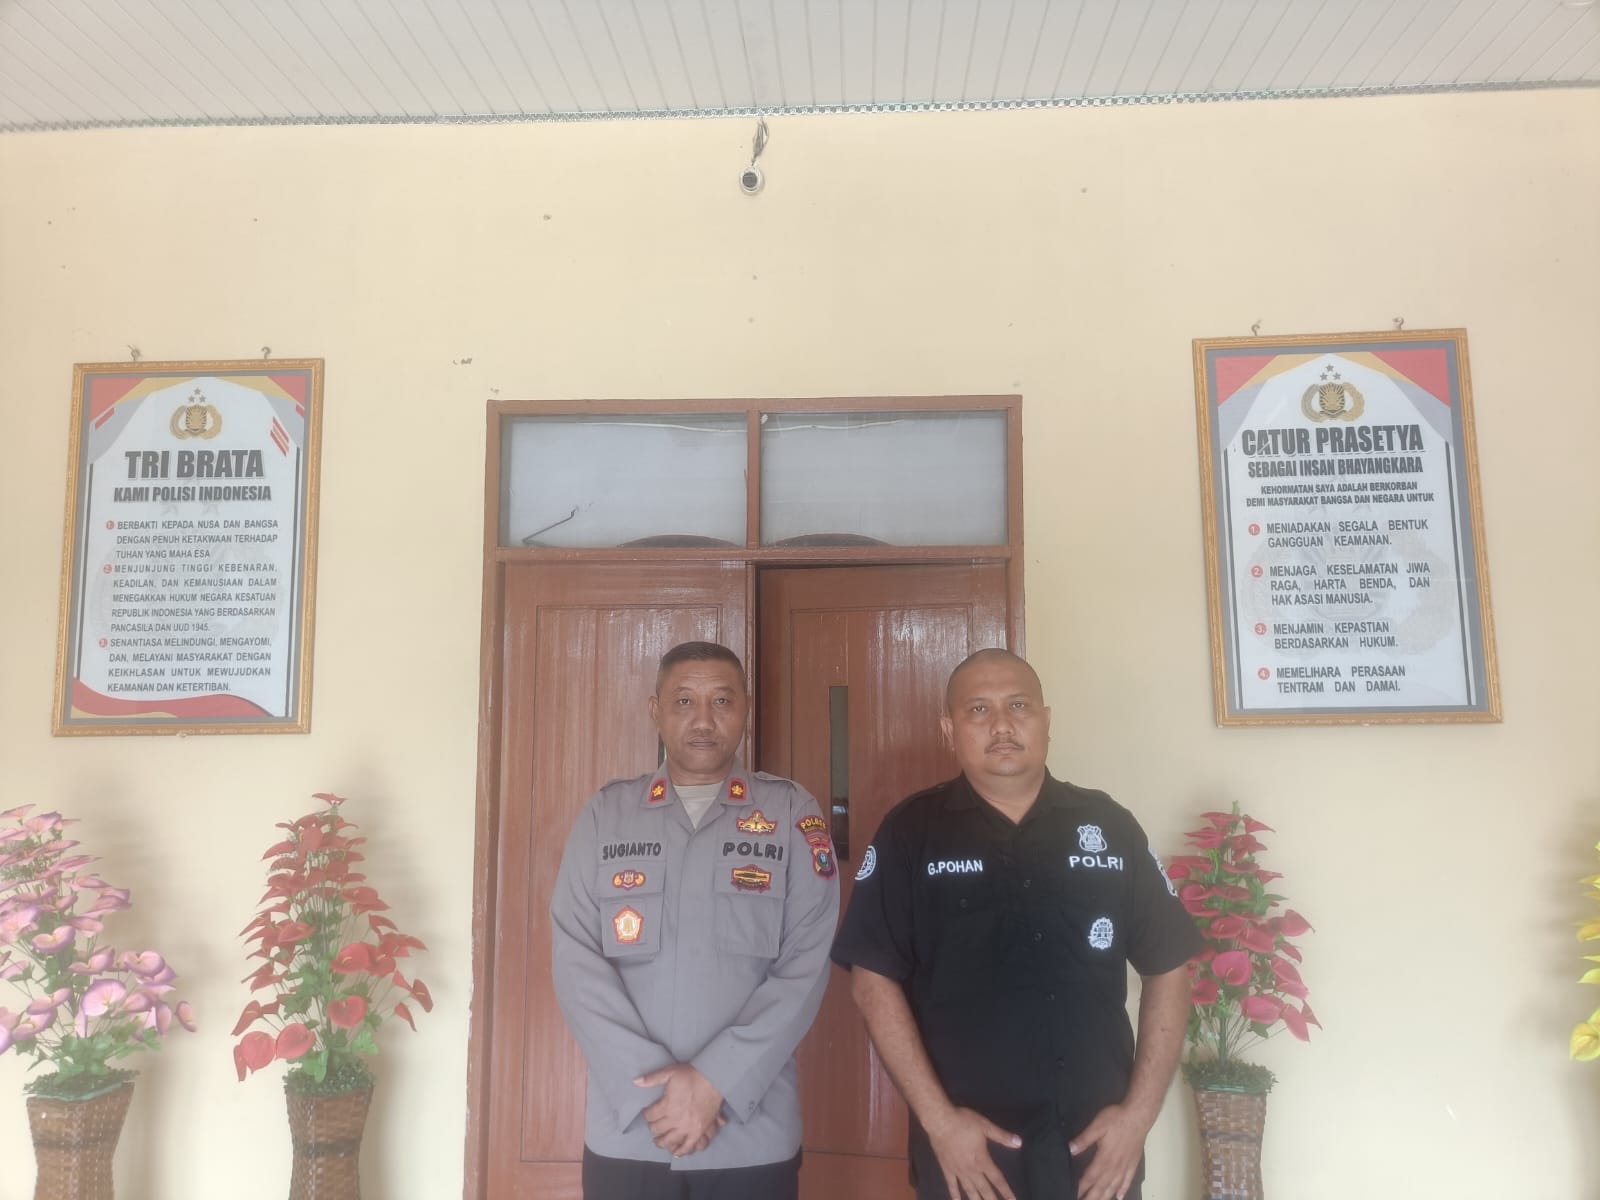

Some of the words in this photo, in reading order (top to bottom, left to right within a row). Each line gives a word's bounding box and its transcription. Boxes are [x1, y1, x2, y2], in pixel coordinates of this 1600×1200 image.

[1242, 428, 1310, 456] CATUR
[1316, 424, 1424, 453] PRASETYA
[125, 451, 170, 478] TRI
[177, 450, 264, 478] BRATA
[1248, 460, 1297, 478] SEBAGAI
[1300, 459, 1335, 476] INSAN
[1338, 456, 1423, 475] BHAYANGKARA
[114, 488, 149, 502] KAMI
[152, 486, 195, 502] POLISI
[199, 486, 272, 501] INDONESIA
[1261, 484, 1314, 495] KEHORMATAN
[1316, 484, 1335, 493] SAYA
[1337, 483, 1368, 492] ADALAH
[1370, 482, 1418, 491] BERKORBAN
[1246, 498, 1265, 507] DEMI
[1267, 496, 1318, 506] MASYARAKAT
[1321, 495, 1352, 505] BANGSA
[1354, 494, 1369, 504] DAN
[1372, 494, 1405, 503] NEGARA
[1407, 493, 1435, 502] UNTUK
[118, 521, 158, 529] BERBAKTI
[162, 520, 194, 529] KEPADA
[198, 520, 220, 528] NUSA
[224, 520, 240, 528] DAN
[245, 520, 278, 528] BANGSA
[1267, 522, 1330, 533] MENIADAKAN
[1339, 521, 1378, 532] SEGALA
[1389, 519, 1429, 530] BENTUK
[117, 536, 150, 544] DENGAN
[152, 535, 179, 544] PENUH
[182, 535, 232, 543] KETAKWAAN
[234, 534, 278, 543] TERHADAP
[1268, 536, 1323, 548] GANGGUAN
[1334, 534, 1392, 546] KEAMANAN.
[145, 550, 167, 558] YANG
[169, 550, 192, 558] MAHA
[194, 550, 210, 558] ESA
[114, 564, 175, 572] MENJUNJUNG
[182, 564, 212, 572] TINGGI
[1270, 565, 1317, 576] MENJAGA
[1327, 563, 1398, 575] KESELAMATAN
[1406, 563, 1430, 573] JIWA
[162, 579, 178, 587] DAN
[184, 579, 243, 587] KEMANUSIAAN
[248, 578, 277, 586] DALAM
[1271, 580, 1301, 591] RAGA,
[1314, 579, 1347, 589] HARTA
[1360, 578, 1396, 589] BENDA,
[1409, 577, 1430, 588] DAN
[113, 594, 166, 602] MENEGAKKAN
[170, 593, 197, 602] HUKUM
[201, 593, 232, 601] NEGARA
[235, 593, 276, 601] KESATUAN
[1272, 595, 1292, 606] HAK
[1294, 594, 1324, 605] ASASI
[1326, 593, 1372, 604] MANUSIA.
[112, 609, 149, 617] REPUBLIK
[152, 608, 192, 617] INDONESIA
[195, 608, 215, 616] YANG
[217, 608, 275, 616] BERDASARKAN
[111, 624, 153, 632] PANCASILA
[156, 624, 172, 632] DAN
[173, 624, 189, 632] UUD
[1274, 623, 1324, 634] MENJAMIN
[1335, 622, 1389, 633] KEPASTIAN
[110, 639, 162, 647] SENANTIASA
[1275, 637, 1349, 649] BERDASARKAN
[1360, 636, 1398, 647] HUKUM.
[132, 653, 173, 662] MELAYANI
[177, 653, 232, 661] MASYARAKAT
[237, 652, 271, 661] DENGAN
[108, 668, 165, 677] KEIKHLASAN
[171, 668, 200, 676] UNTUK
[207, 668, 271, 676] MEWUJUDKAN
[1277, 667, 1341, 678] MEMELIHARA
[1351, 666, 1406, 676] PERASAAN
[108, 683, 154, 692] KEAMANAN
[157, 683, 174, 691] DAN
[177, 682, 230, 691] KETERTIBAN.
[1277, 682, 1324, 693] TENTRAM
[1335, 681, 1356, 692] DAN
[1366, 680, 1400, 692] DAMAI.
[602, 842, 662, 860] SUGIANTO
[723, 841, 784, 861] POLRI
[927, 859, 983, 875] G.POHAN
[1069, 855, 1124, 871] POLRI
